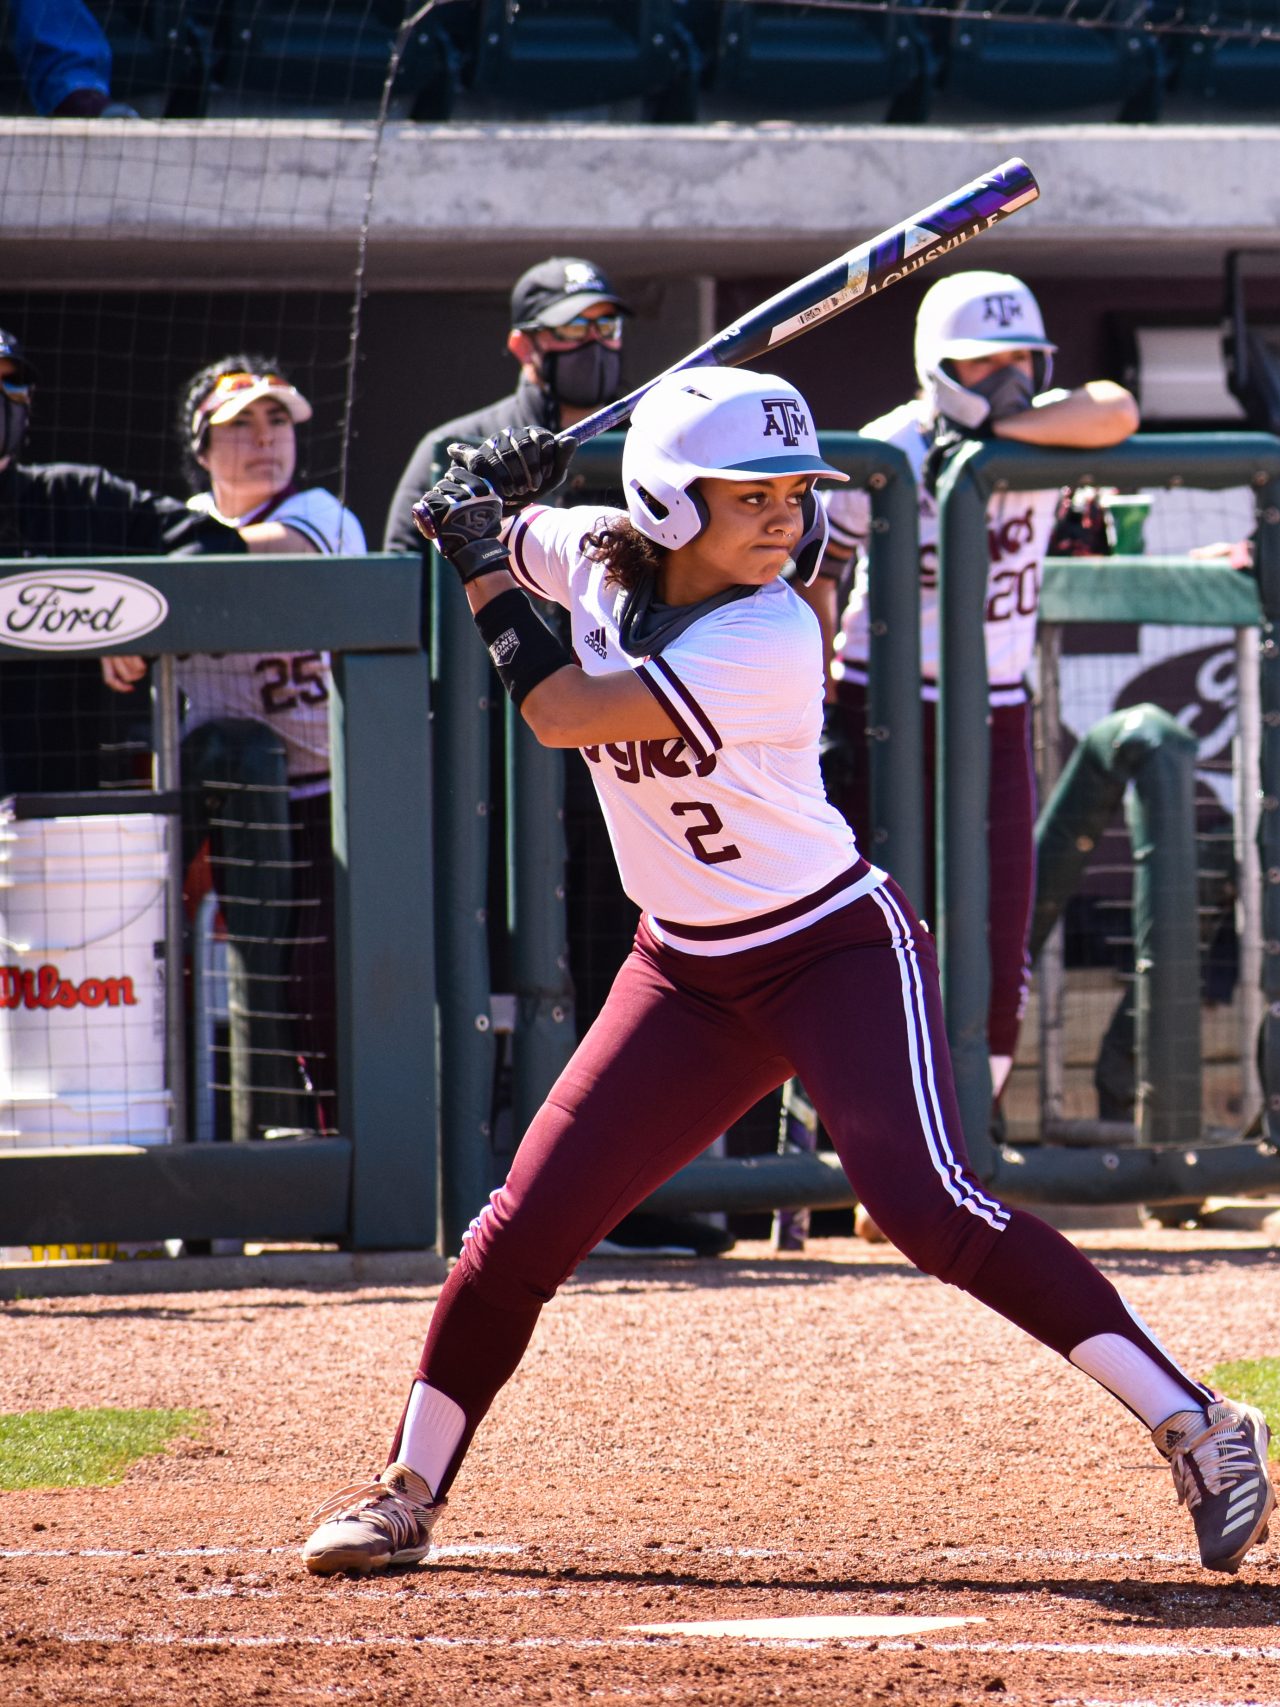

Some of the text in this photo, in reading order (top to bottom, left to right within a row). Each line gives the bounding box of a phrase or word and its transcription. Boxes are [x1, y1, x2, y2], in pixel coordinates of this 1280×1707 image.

[7, 583, 125, 632] Ford
[985, 562, 1038, 622] 20
[584, 634, 608, 660] adidas
[255, 655, 329, 714] 25
[670, 801, 742, 865] 2
